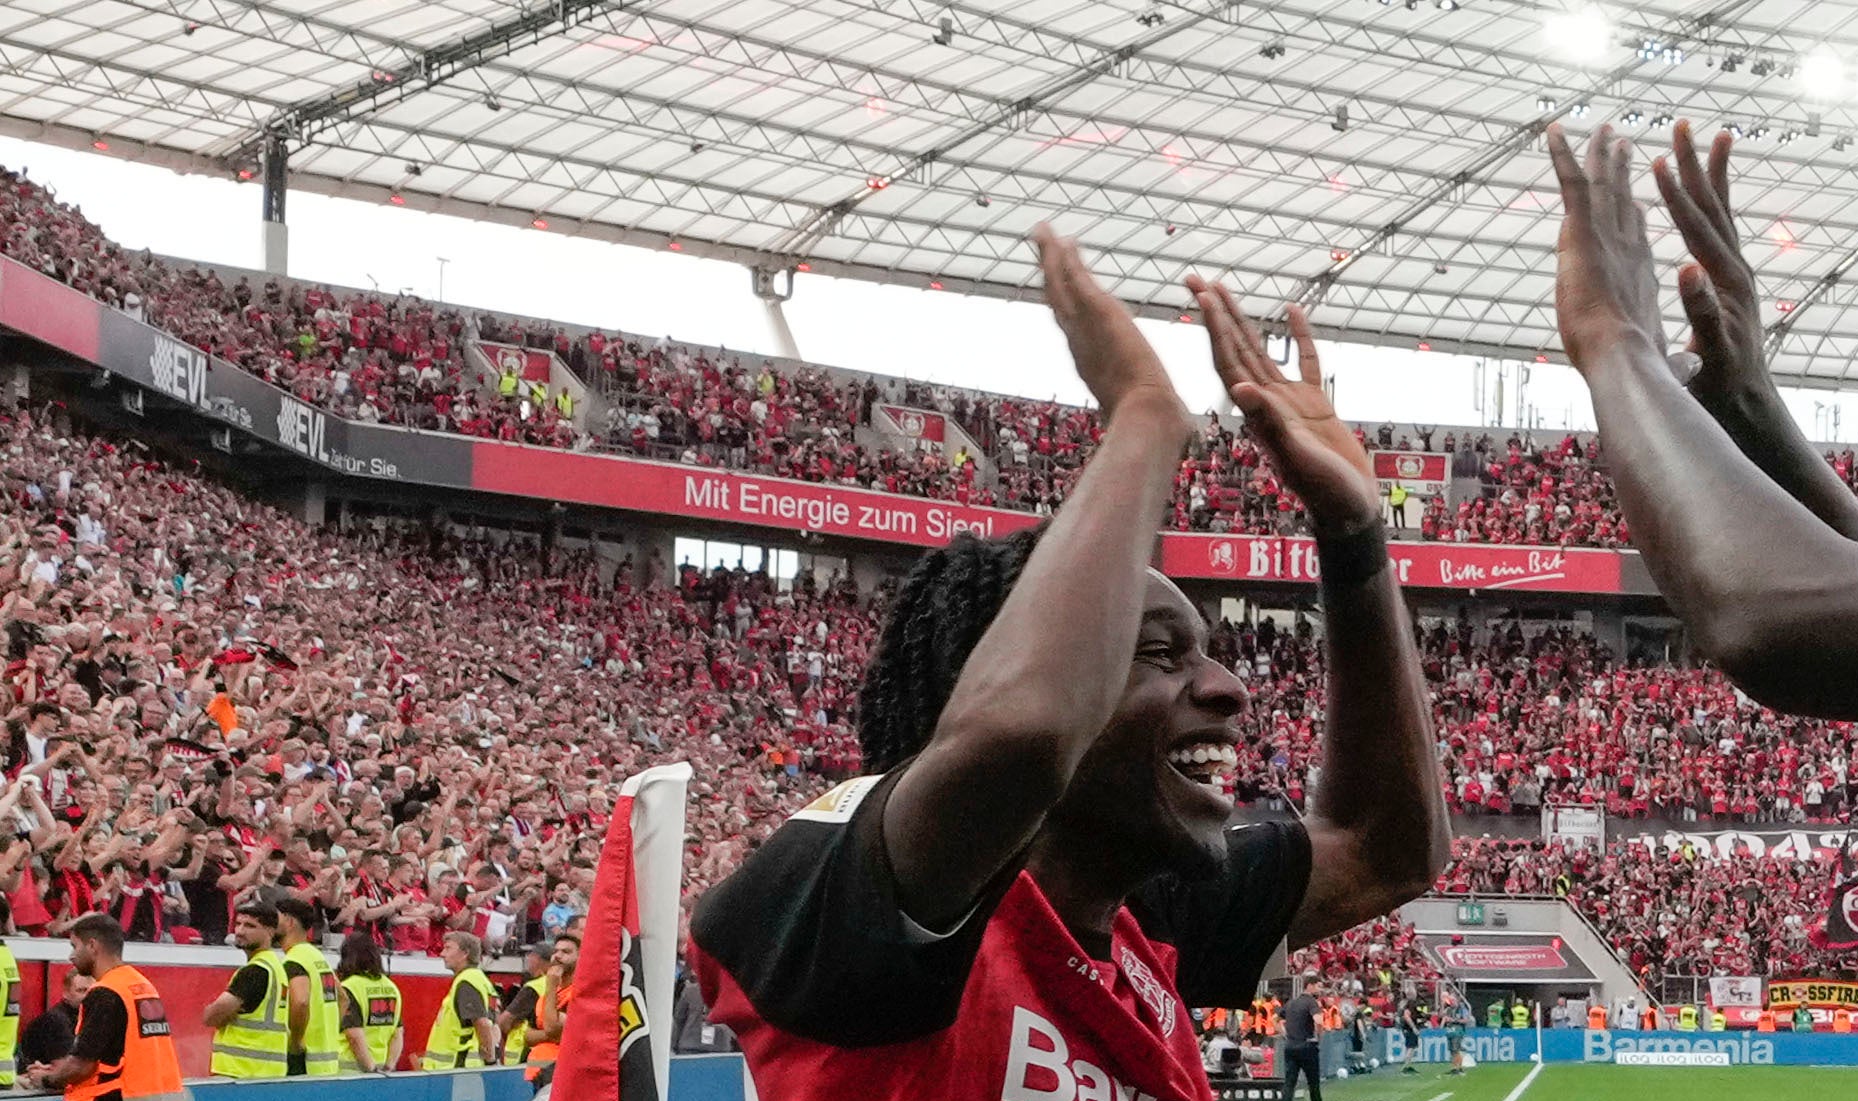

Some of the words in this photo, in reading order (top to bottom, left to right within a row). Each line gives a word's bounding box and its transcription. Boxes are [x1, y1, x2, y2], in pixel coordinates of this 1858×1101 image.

[296, 402, 330, 463] EVL
[684, 476, 730, 511] Mit
[739, 482, 850, 529] Energie
[858, 505, 917, 535] zum
[1440, 560, 1486, 584] Bitte
[1490, 563, 1524, 578] ein
[1528, 552, 1566, 574] Bit
[1584, 1029, 1775, 1064] Barmenia
